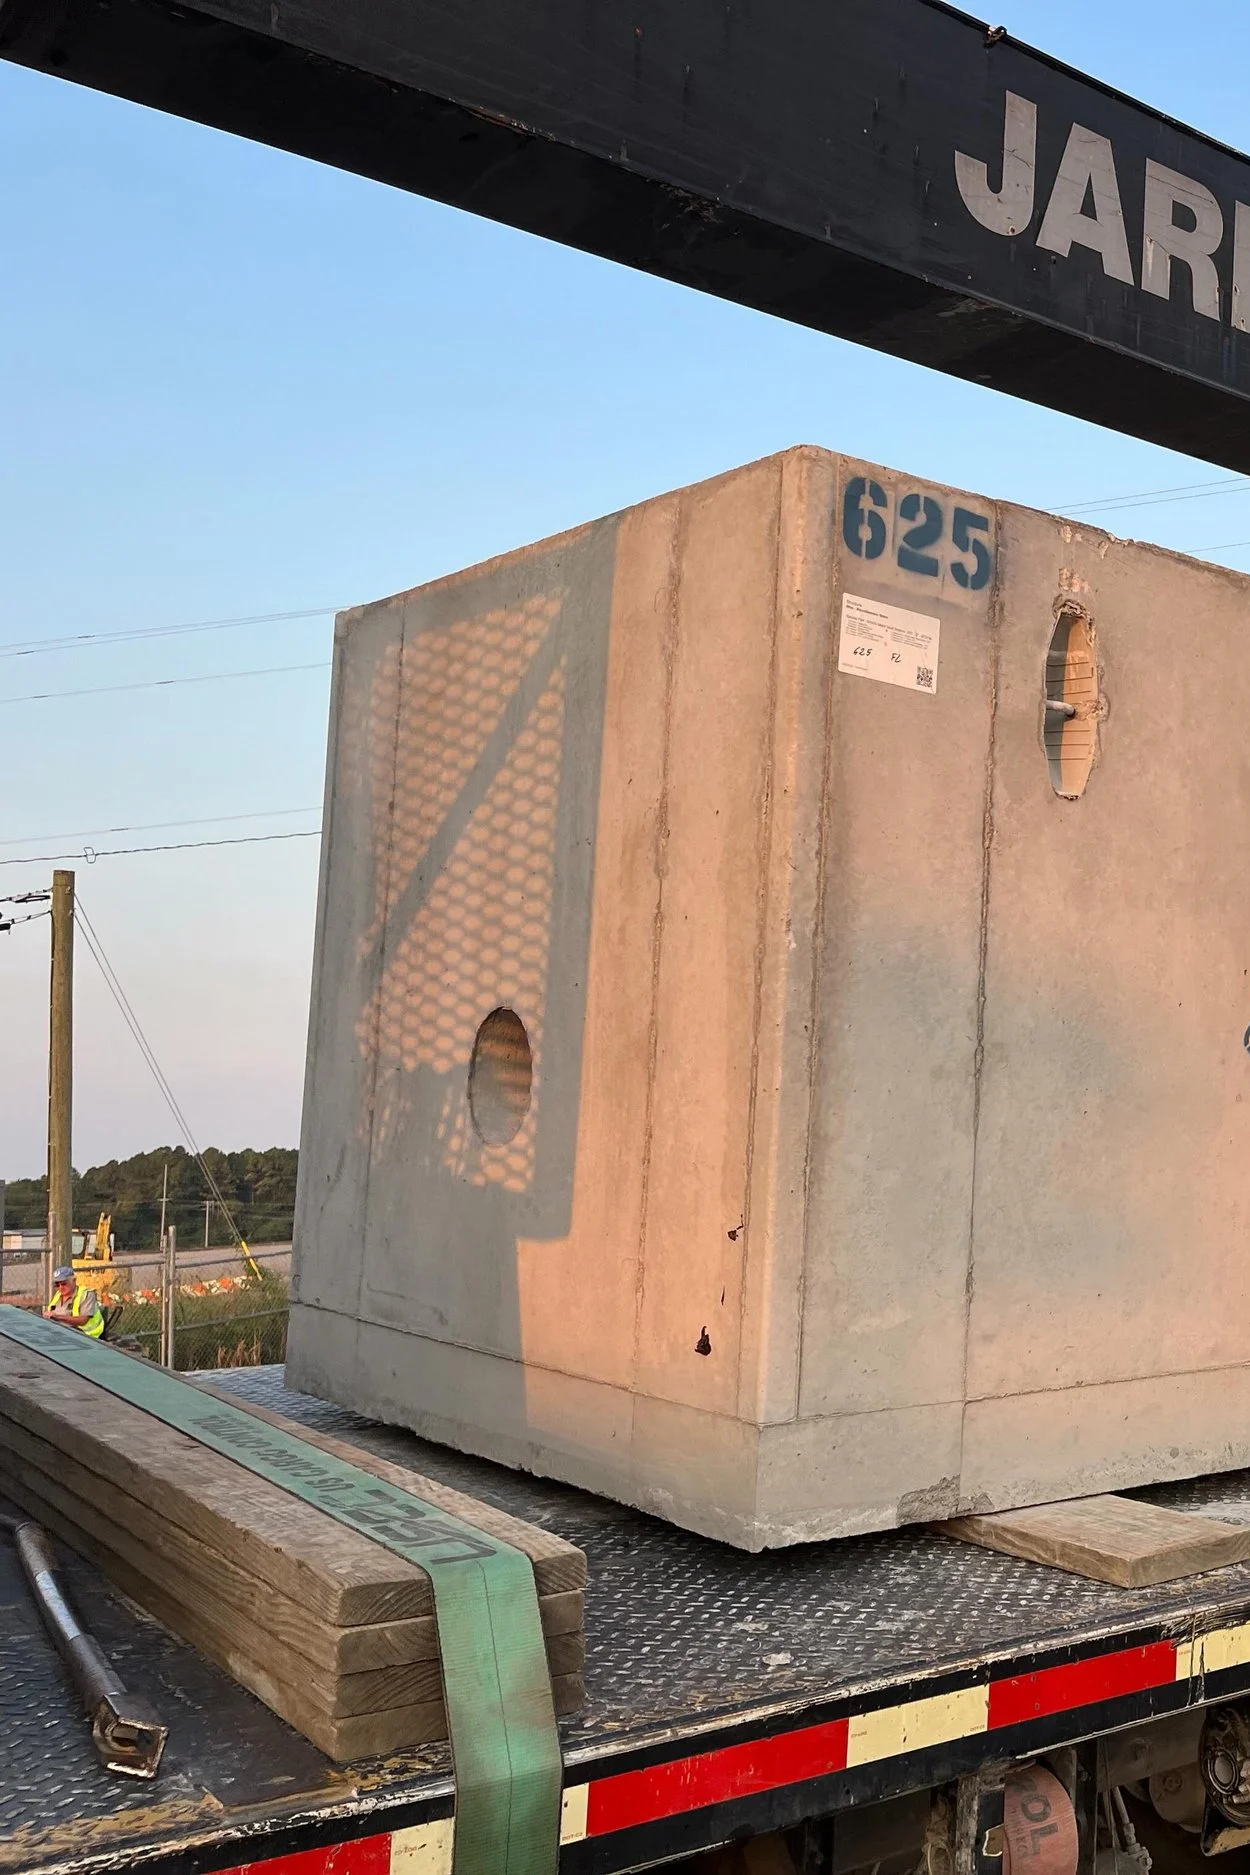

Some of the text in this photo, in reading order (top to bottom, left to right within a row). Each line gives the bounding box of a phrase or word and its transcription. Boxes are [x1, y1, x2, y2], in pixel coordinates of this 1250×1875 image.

[843, 476, 990, 590] 625
[853, 646, 872, 656] 625
[304, 1477, 355, 1492] US
